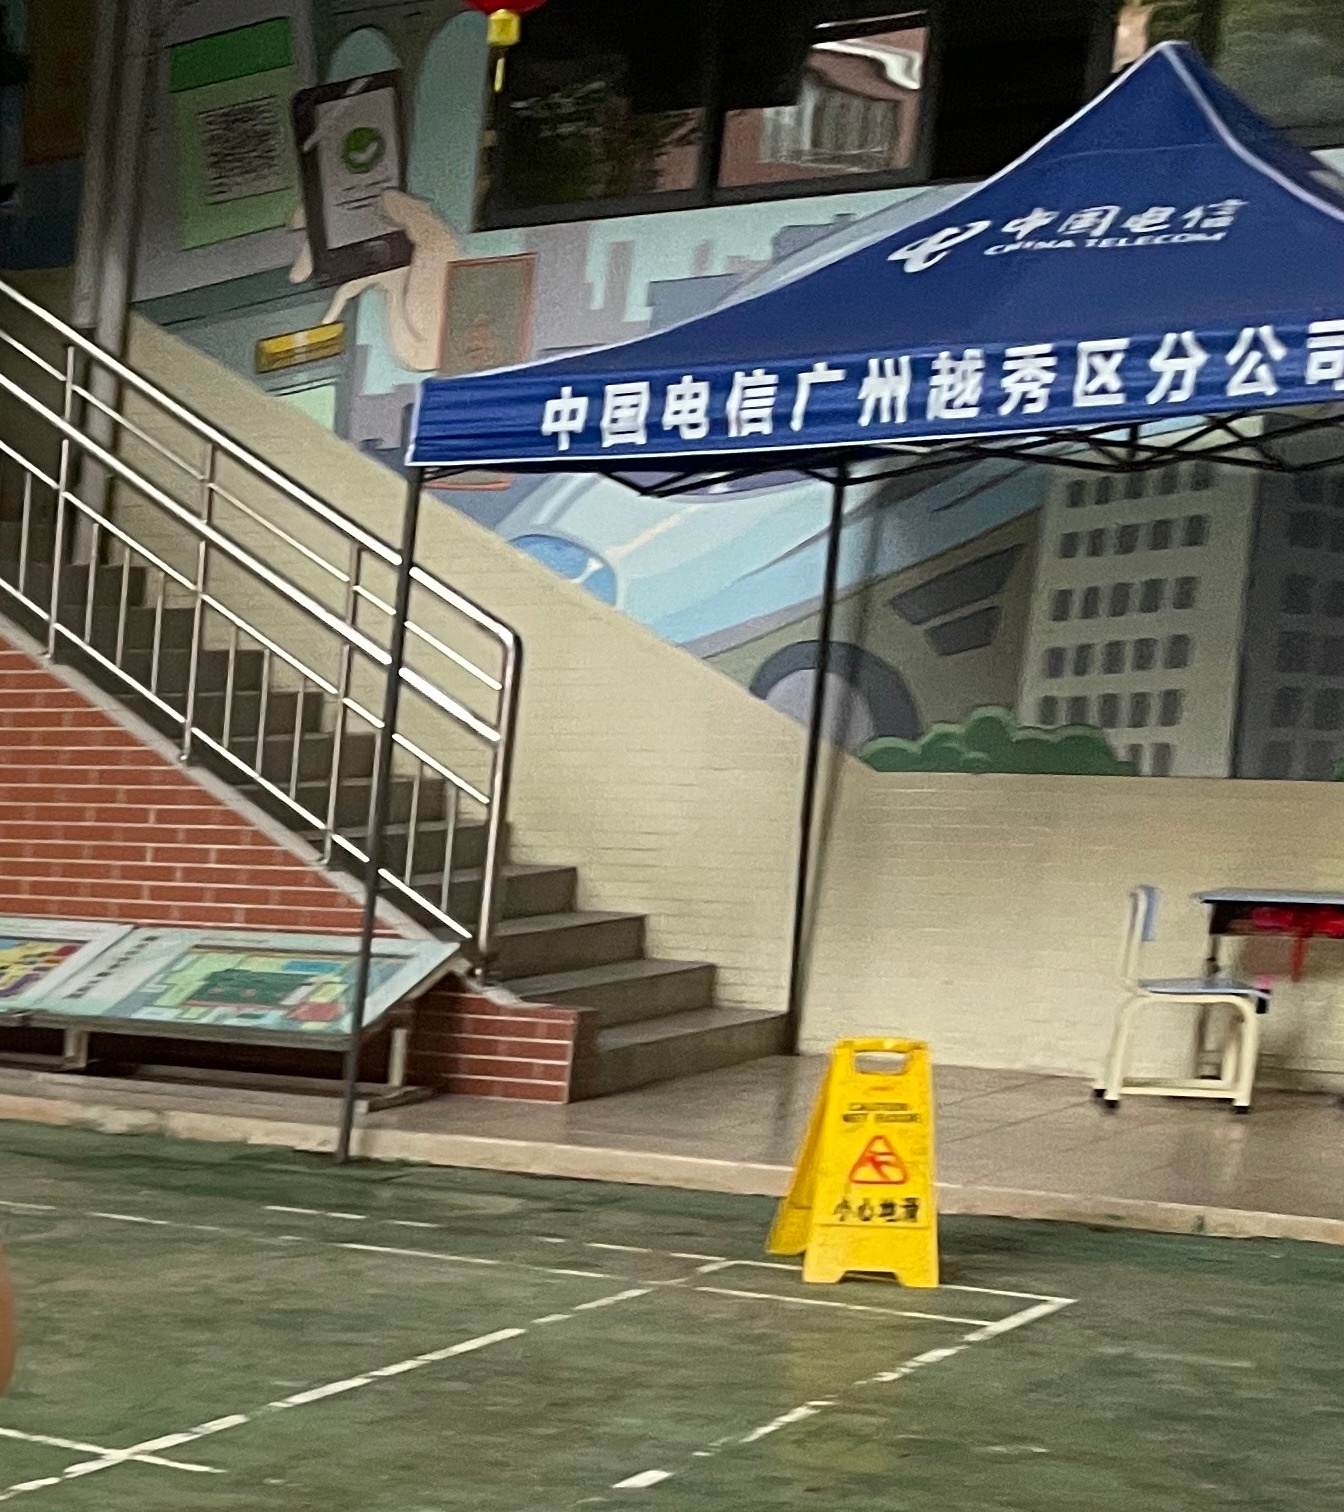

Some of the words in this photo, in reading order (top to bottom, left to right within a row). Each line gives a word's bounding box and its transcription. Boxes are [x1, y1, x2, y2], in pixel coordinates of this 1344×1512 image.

[1002, 199, 1248, 239] 中国电信
[983, 239, 1076, 255] CHINA
[1084, 231, 1227, 248] TELECOM
[539, 319, 1344, 451] 中国电信广州越秀区分公司
[833, 1197, 920, 1223] 小心地滑
